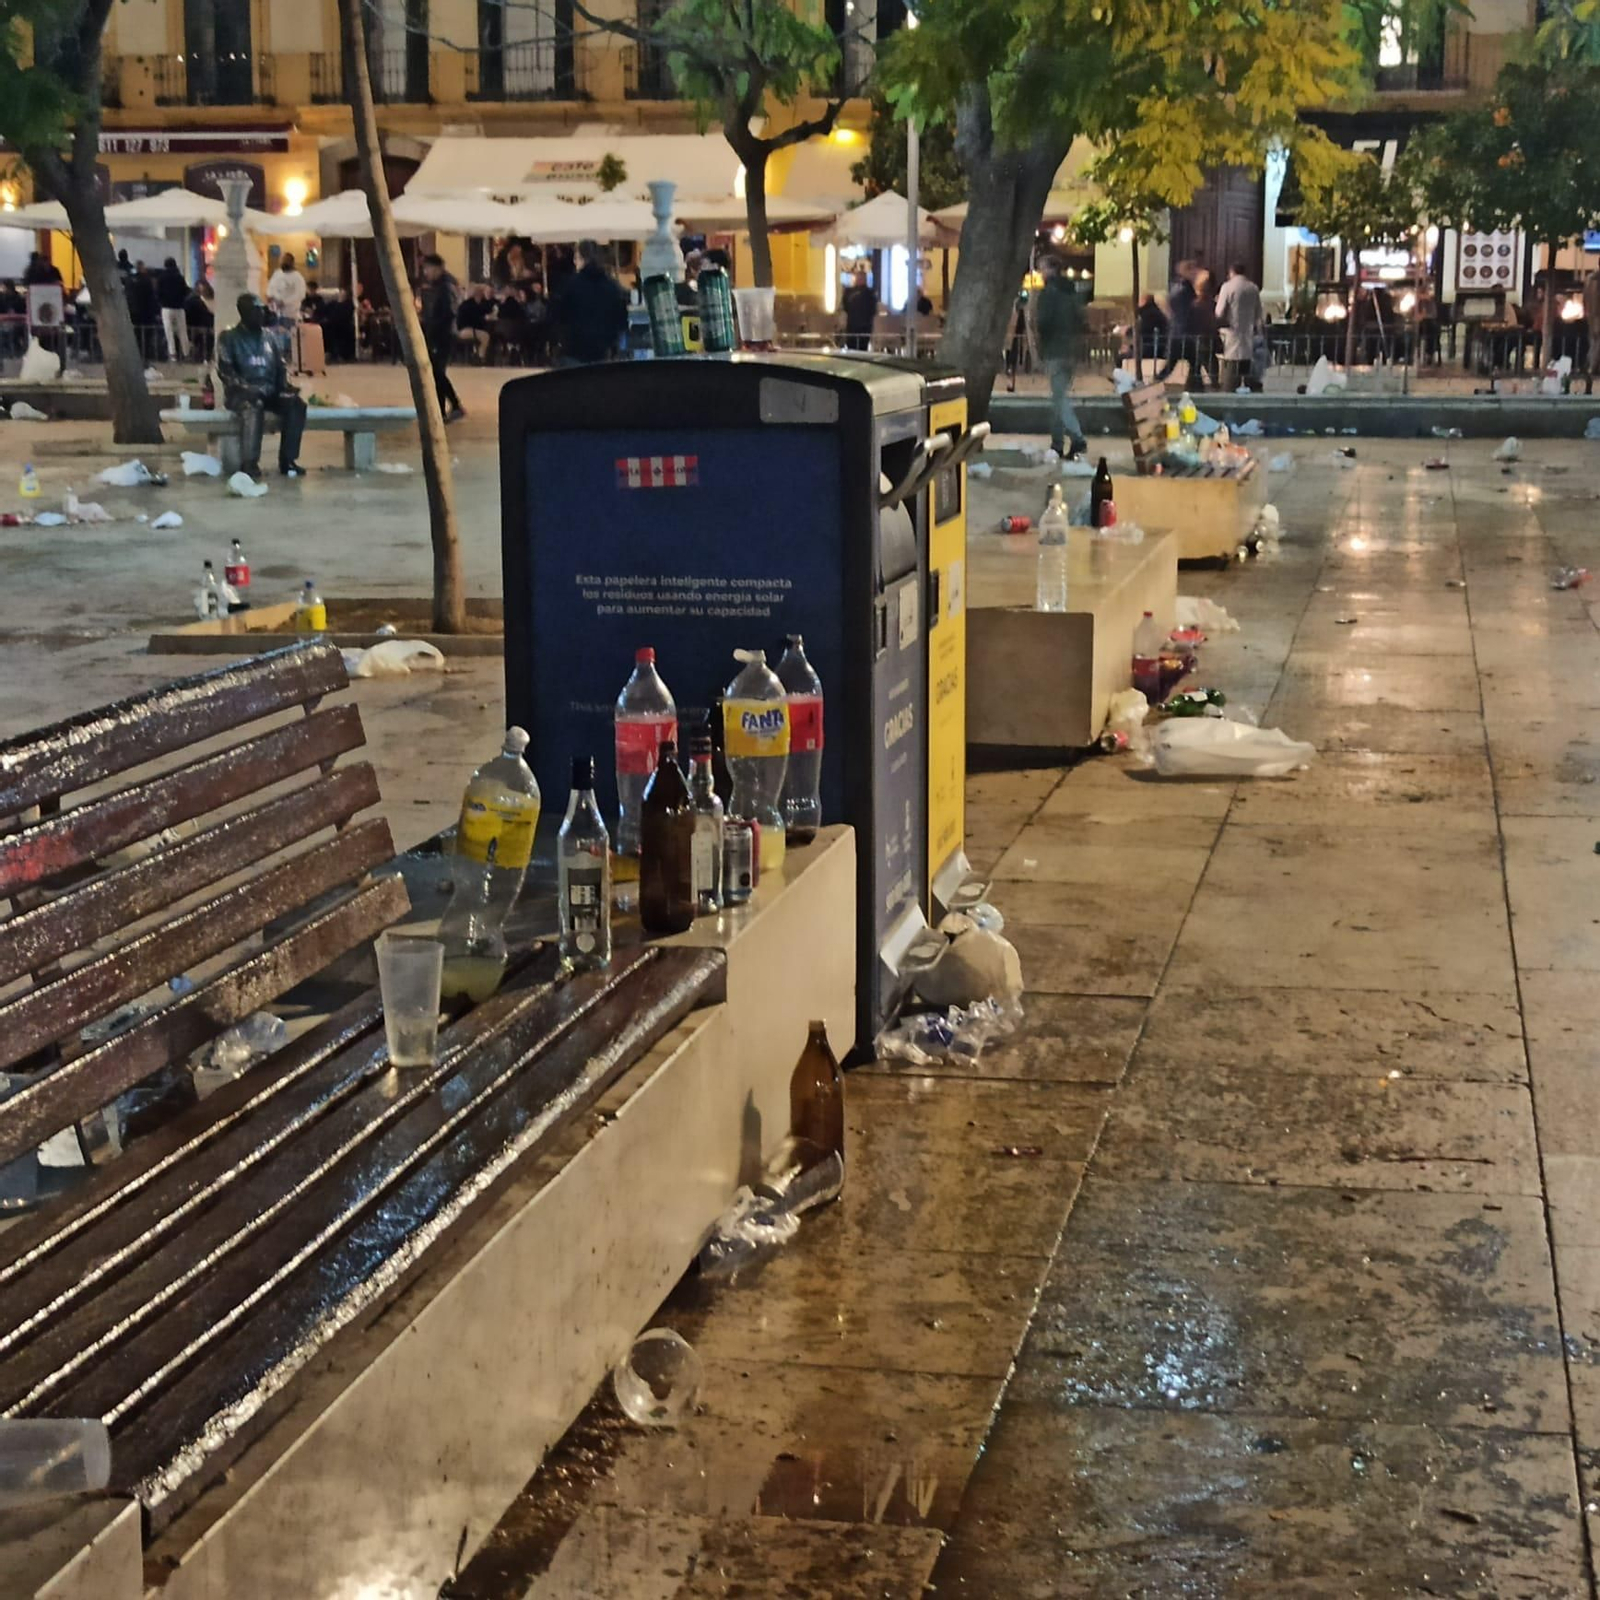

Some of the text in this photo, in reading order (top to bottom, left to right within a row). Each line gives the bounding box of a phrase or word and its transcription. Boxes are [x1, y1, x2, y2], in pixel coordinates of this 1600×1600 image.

[576, 574, 792, 590] Esta papelera inteligente compacta
[582, 588, 600, 599] los
[602, 590, 654, 600] residuos
[657, 591, 703, 601] usando
[755, 591, 785, 602] solar
[597, 604, 771, 617] para aumentar su capacidad
[884, 702, 914, 750] GRACIAS
